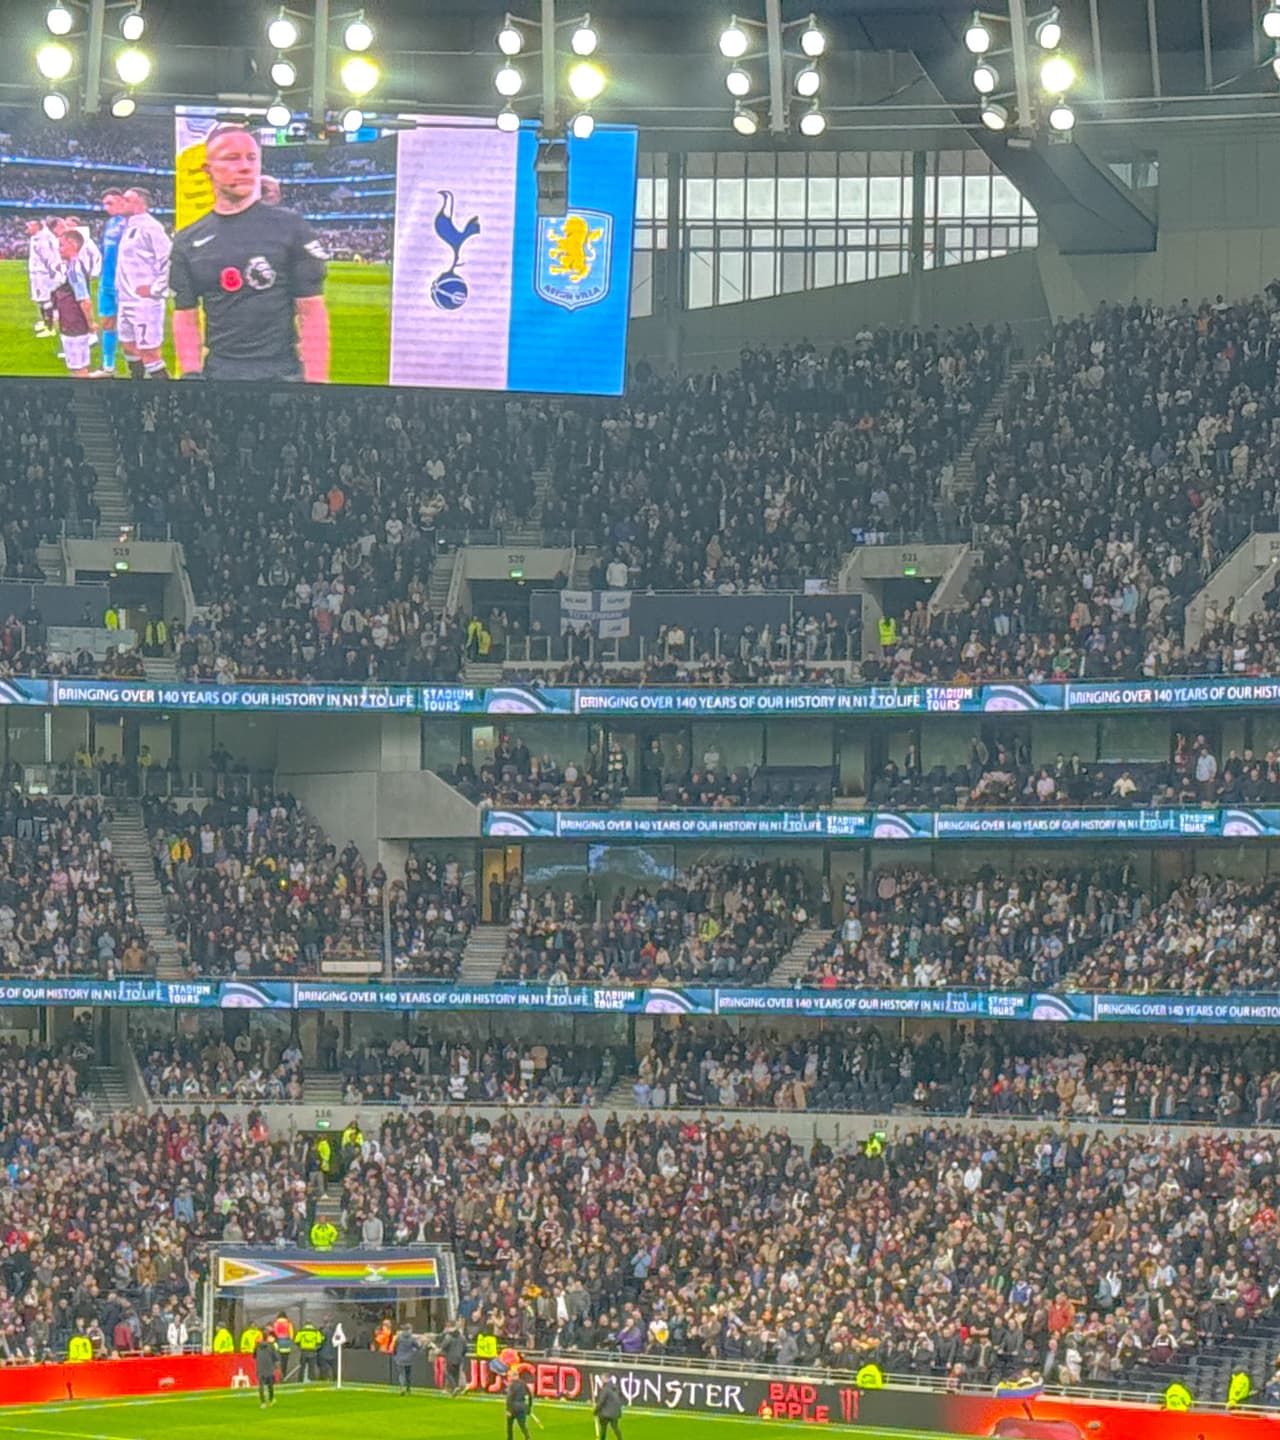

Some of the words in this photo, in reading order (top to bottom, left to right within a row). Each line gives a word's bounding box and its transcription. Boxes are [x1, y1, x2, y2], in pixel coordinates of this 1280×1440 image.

[59, 688, 118, 701] BRINGING
[122, 690, 154, 703] OVER
[159, 691, 179, 702] 140
[182, 691, 219, 704] YEARS
[222, 692, 238, 704] OF
[242, 693, 268, 705] OUR
[272, 694, 324, 705] HISTORY
[327, 695, 340, 706] IN
[343, 694, 367, 706] N17
[369, 694, 388, 708] TO
[389, 695, 413, 707] LIFE
[770, 1383, 818, 1404] BAD
